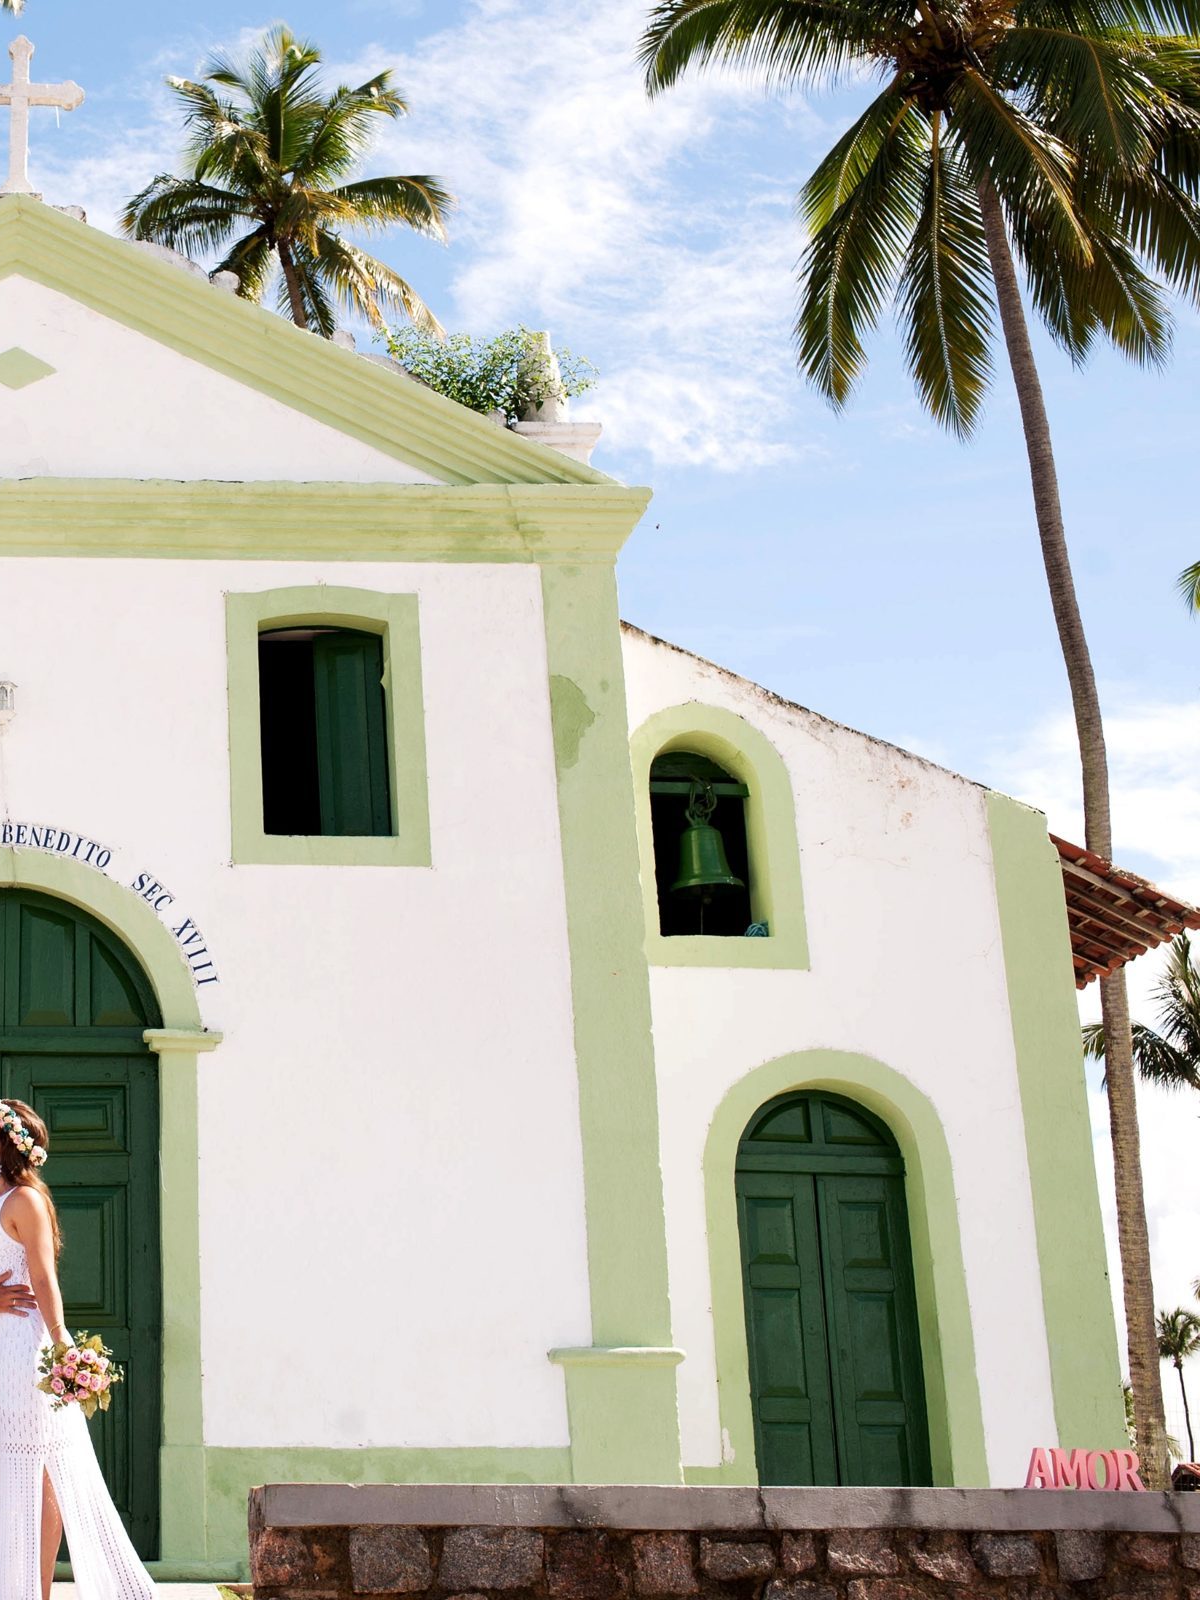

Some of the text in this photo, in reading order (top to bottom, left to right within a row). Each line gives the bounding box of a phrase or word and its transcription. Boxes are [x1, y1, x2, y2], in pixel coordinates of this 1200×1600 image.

[1, 823, 112, 869] BENEDITO
[131, 872, 174, 912] SEC
[172, 918, 218, 986] XVIII
[1023, 1447, 1147, 1492] AMOR
